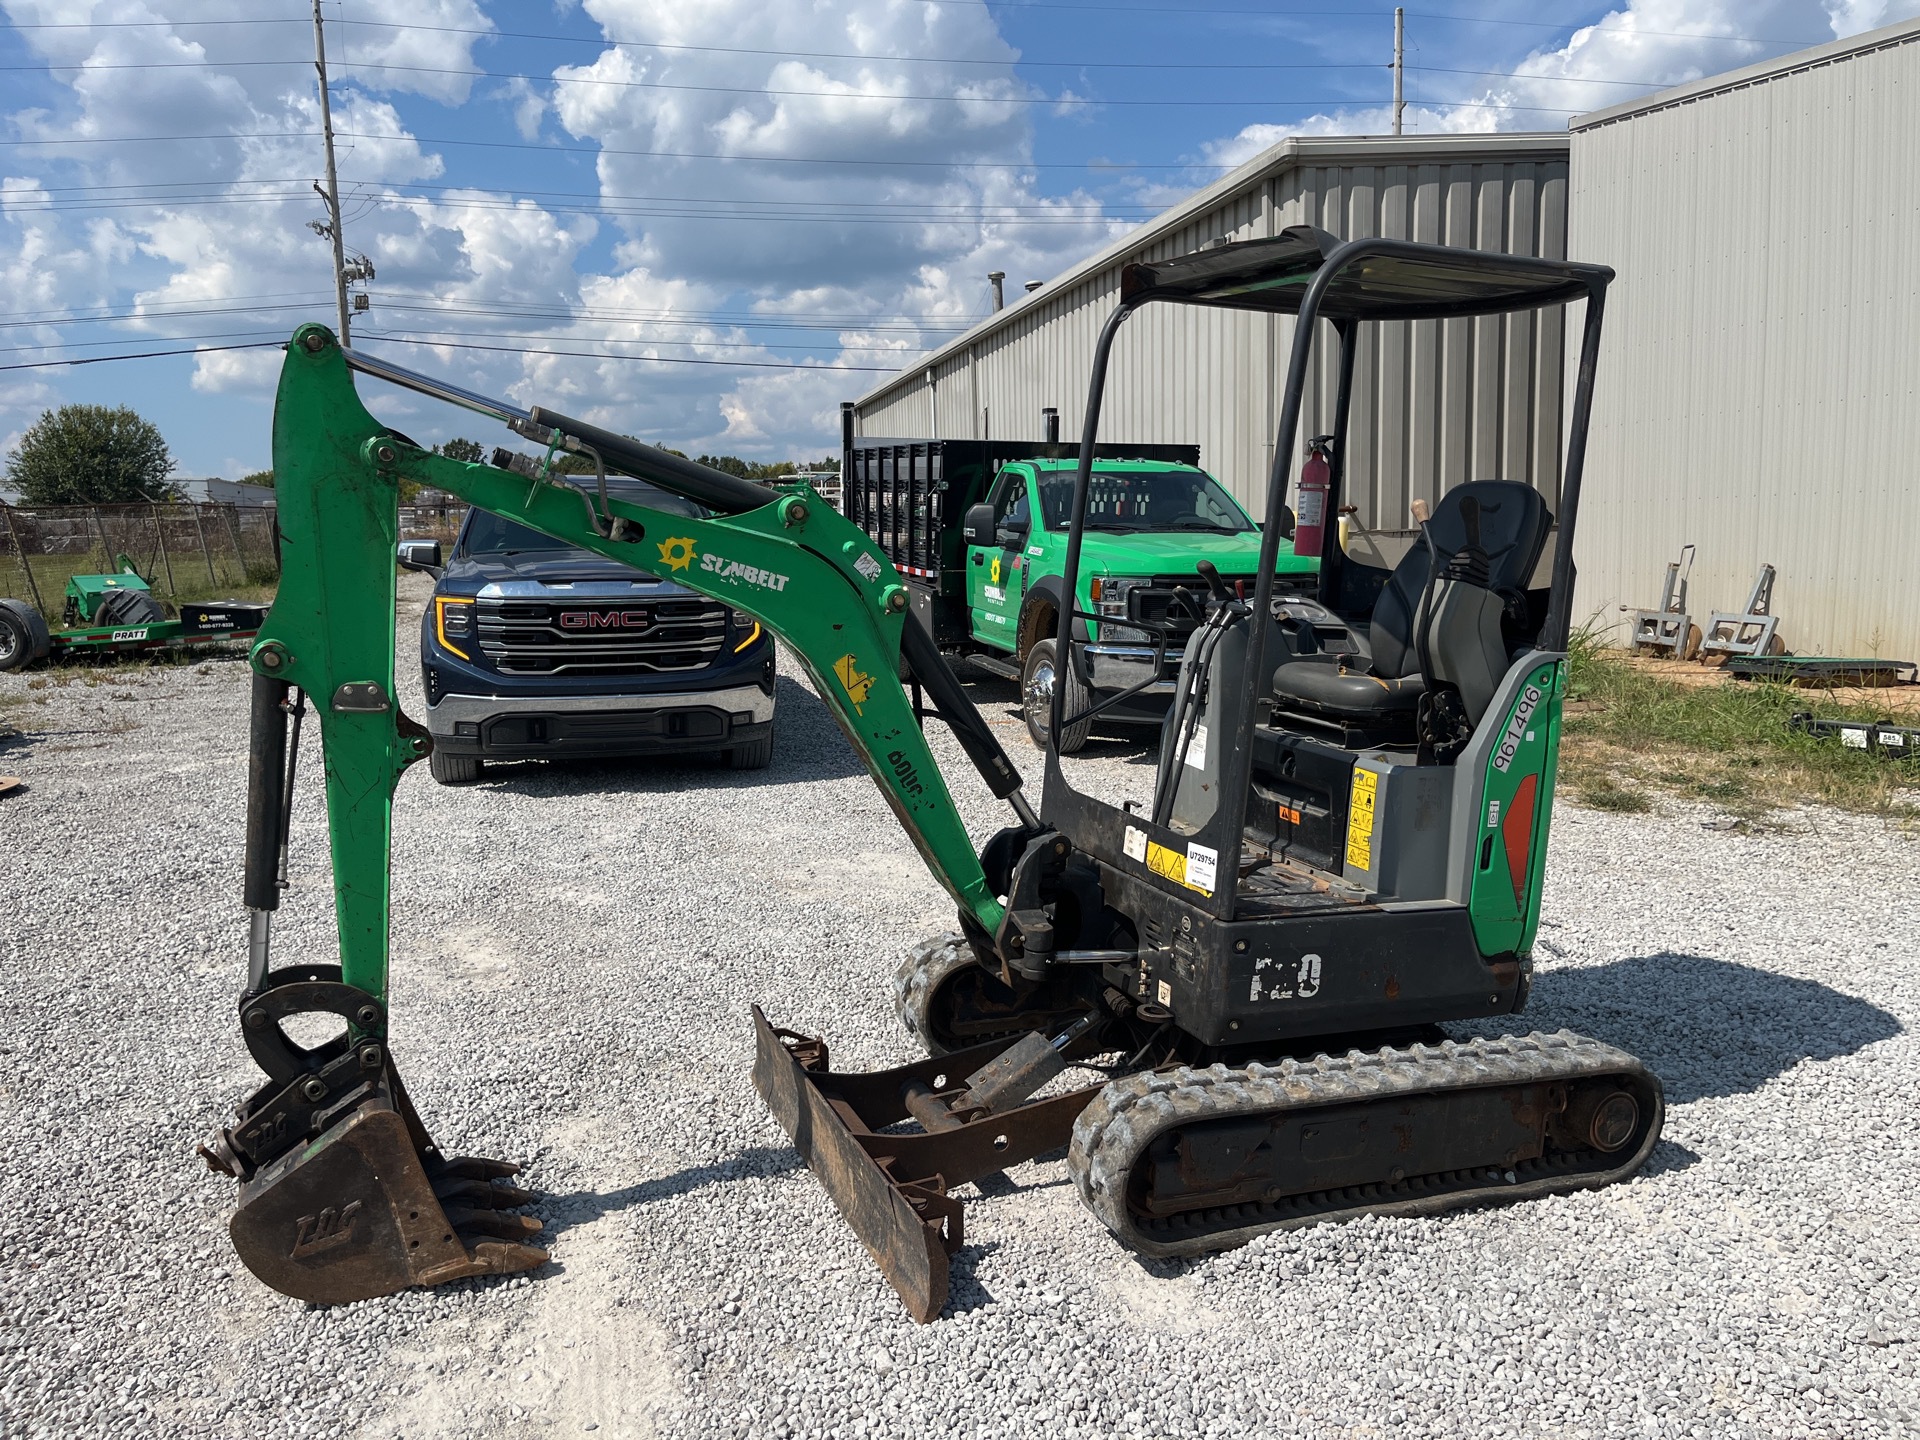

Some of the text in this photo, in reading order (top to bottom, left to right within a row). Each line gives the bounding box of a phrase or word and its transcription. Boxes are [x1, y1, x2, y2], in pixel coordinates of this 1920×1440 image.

[700, 553, 790, 592] SUNBELT
[560, 610, 648, 629] GMC
[114, 630, 146, 640] PRATT
[1494, 686, 1539, 769] 961496
[1189, 850, 1216, 867] U729754
